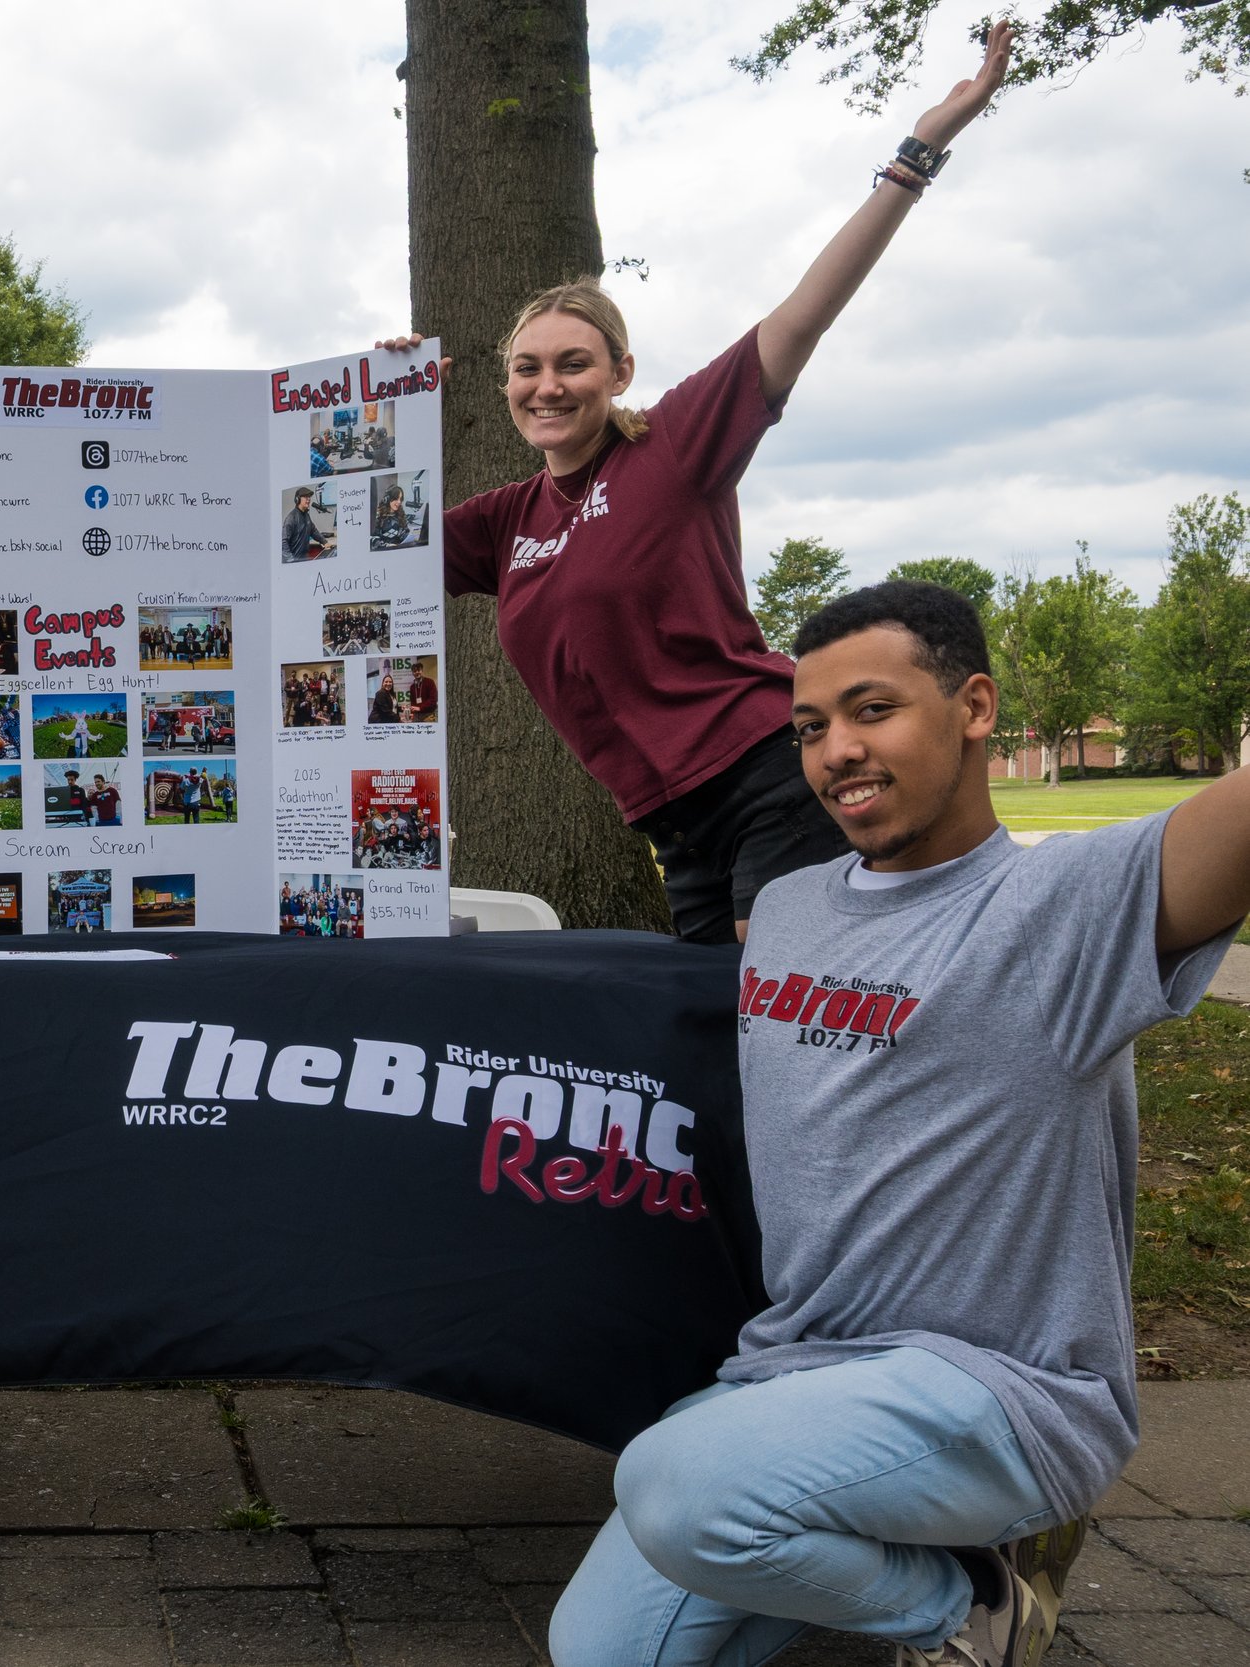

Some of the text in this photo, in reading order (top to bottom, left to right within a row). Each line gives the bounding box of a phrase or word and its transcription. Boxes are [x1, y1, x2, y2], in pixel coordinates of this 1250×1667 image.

[86, 378, 144, 387] Rider University
[271, 357, 439, 413] Engaged Learning
[2, 377, 154, 409] TheBronc
[3, 407, 45, 418] WRRC
[83, 408, 151, 420] 107.7 FM
[113, 450, 188, 463] 1077thebronc
[145, 493, 175, 506] WRRC
[180, 493, 197, 506] The
[202, 492, 232, 506] Bronc
[339, 489, 366, 499] Student
[583, 503, 609, 522] FM
[114, 533, 228, 551] 1077thebronc.com
[313, 568, 388, 597] Awards!
[8, 593, 33, 605] Wars!
[396, 598, 412, 606] 2025
[23, 604, 125, 639] Campus
[417, 629, 436, 637] Media
[34, 636, 117, 671] Events
[392, 658, 412, 670] IBS
[87, 673, 114, 692] Egg
[122, 673, 160, 689] Hunt!
[294, 768, 321, 782] 2025
[371, 775, 416, 787] RADIOTHON
[278, 785, 339, 804] Radiothon!
[4, 835, 155, 857] Scream Screen!
[368, 879, 441, 894] Grand Total:
[796, 1027, 862, 1054] 107.7
[446, 1043, 666, 1100] Rider University
[125, 1019, 696, 1173] TheBronc
[121, 1104, 228, 1127] WRRC2
[479, 1115, 710, 1222] Retro
